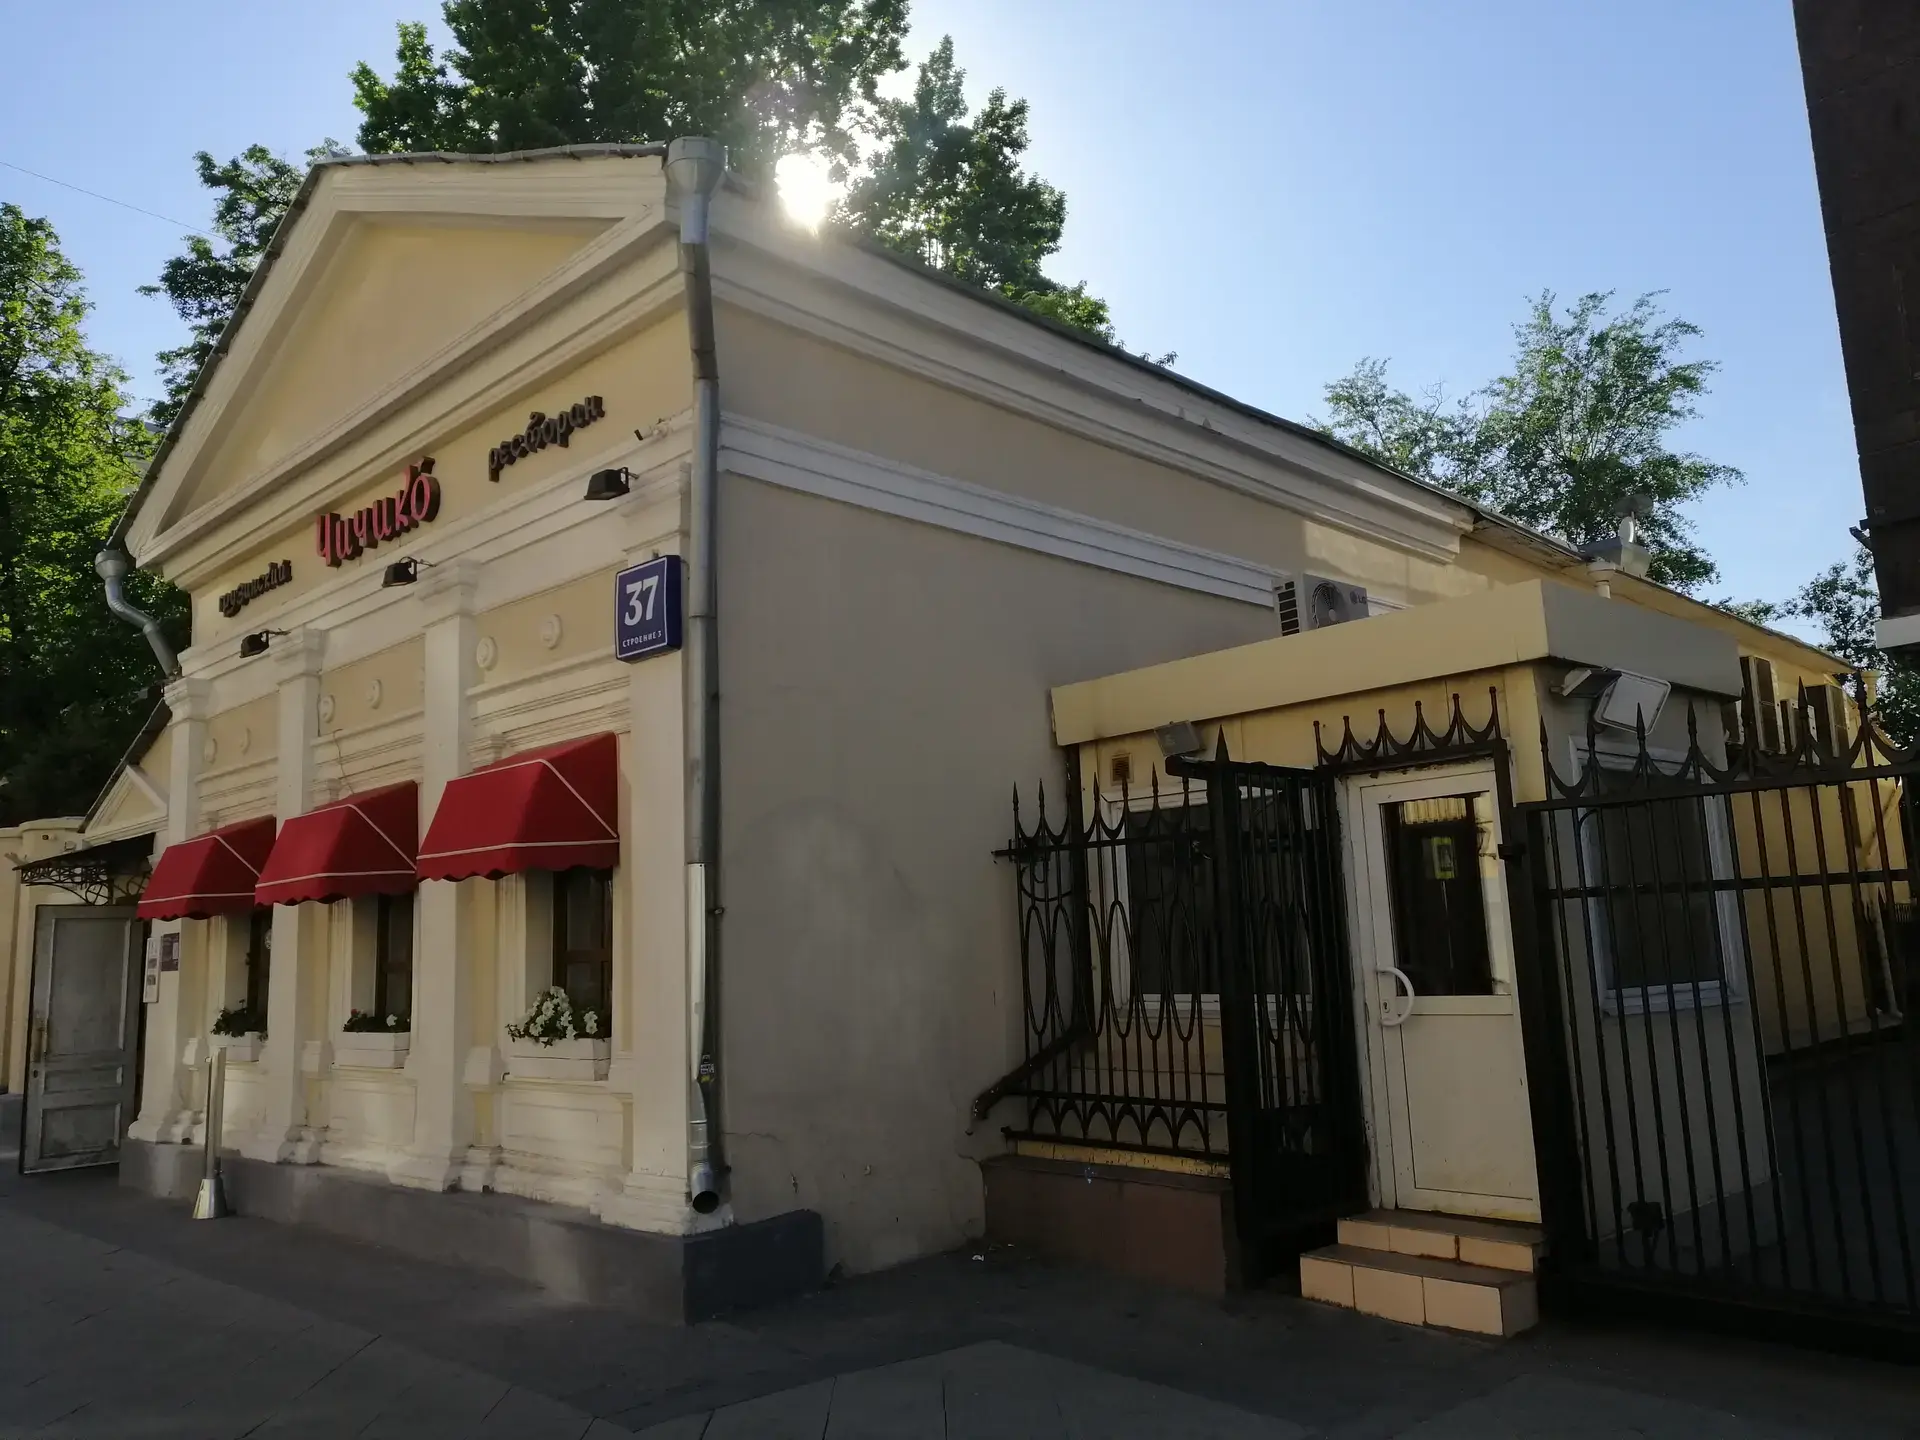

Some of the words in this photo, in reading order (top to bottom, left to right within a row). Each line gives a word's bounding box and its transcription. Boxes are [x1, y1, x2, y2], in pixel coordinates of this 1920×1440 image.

[489, 395, 605, 483] ресторан
[624, 575, 659, 626] 37
[622, 631, 656, 648] СТРОЕНИЕ
